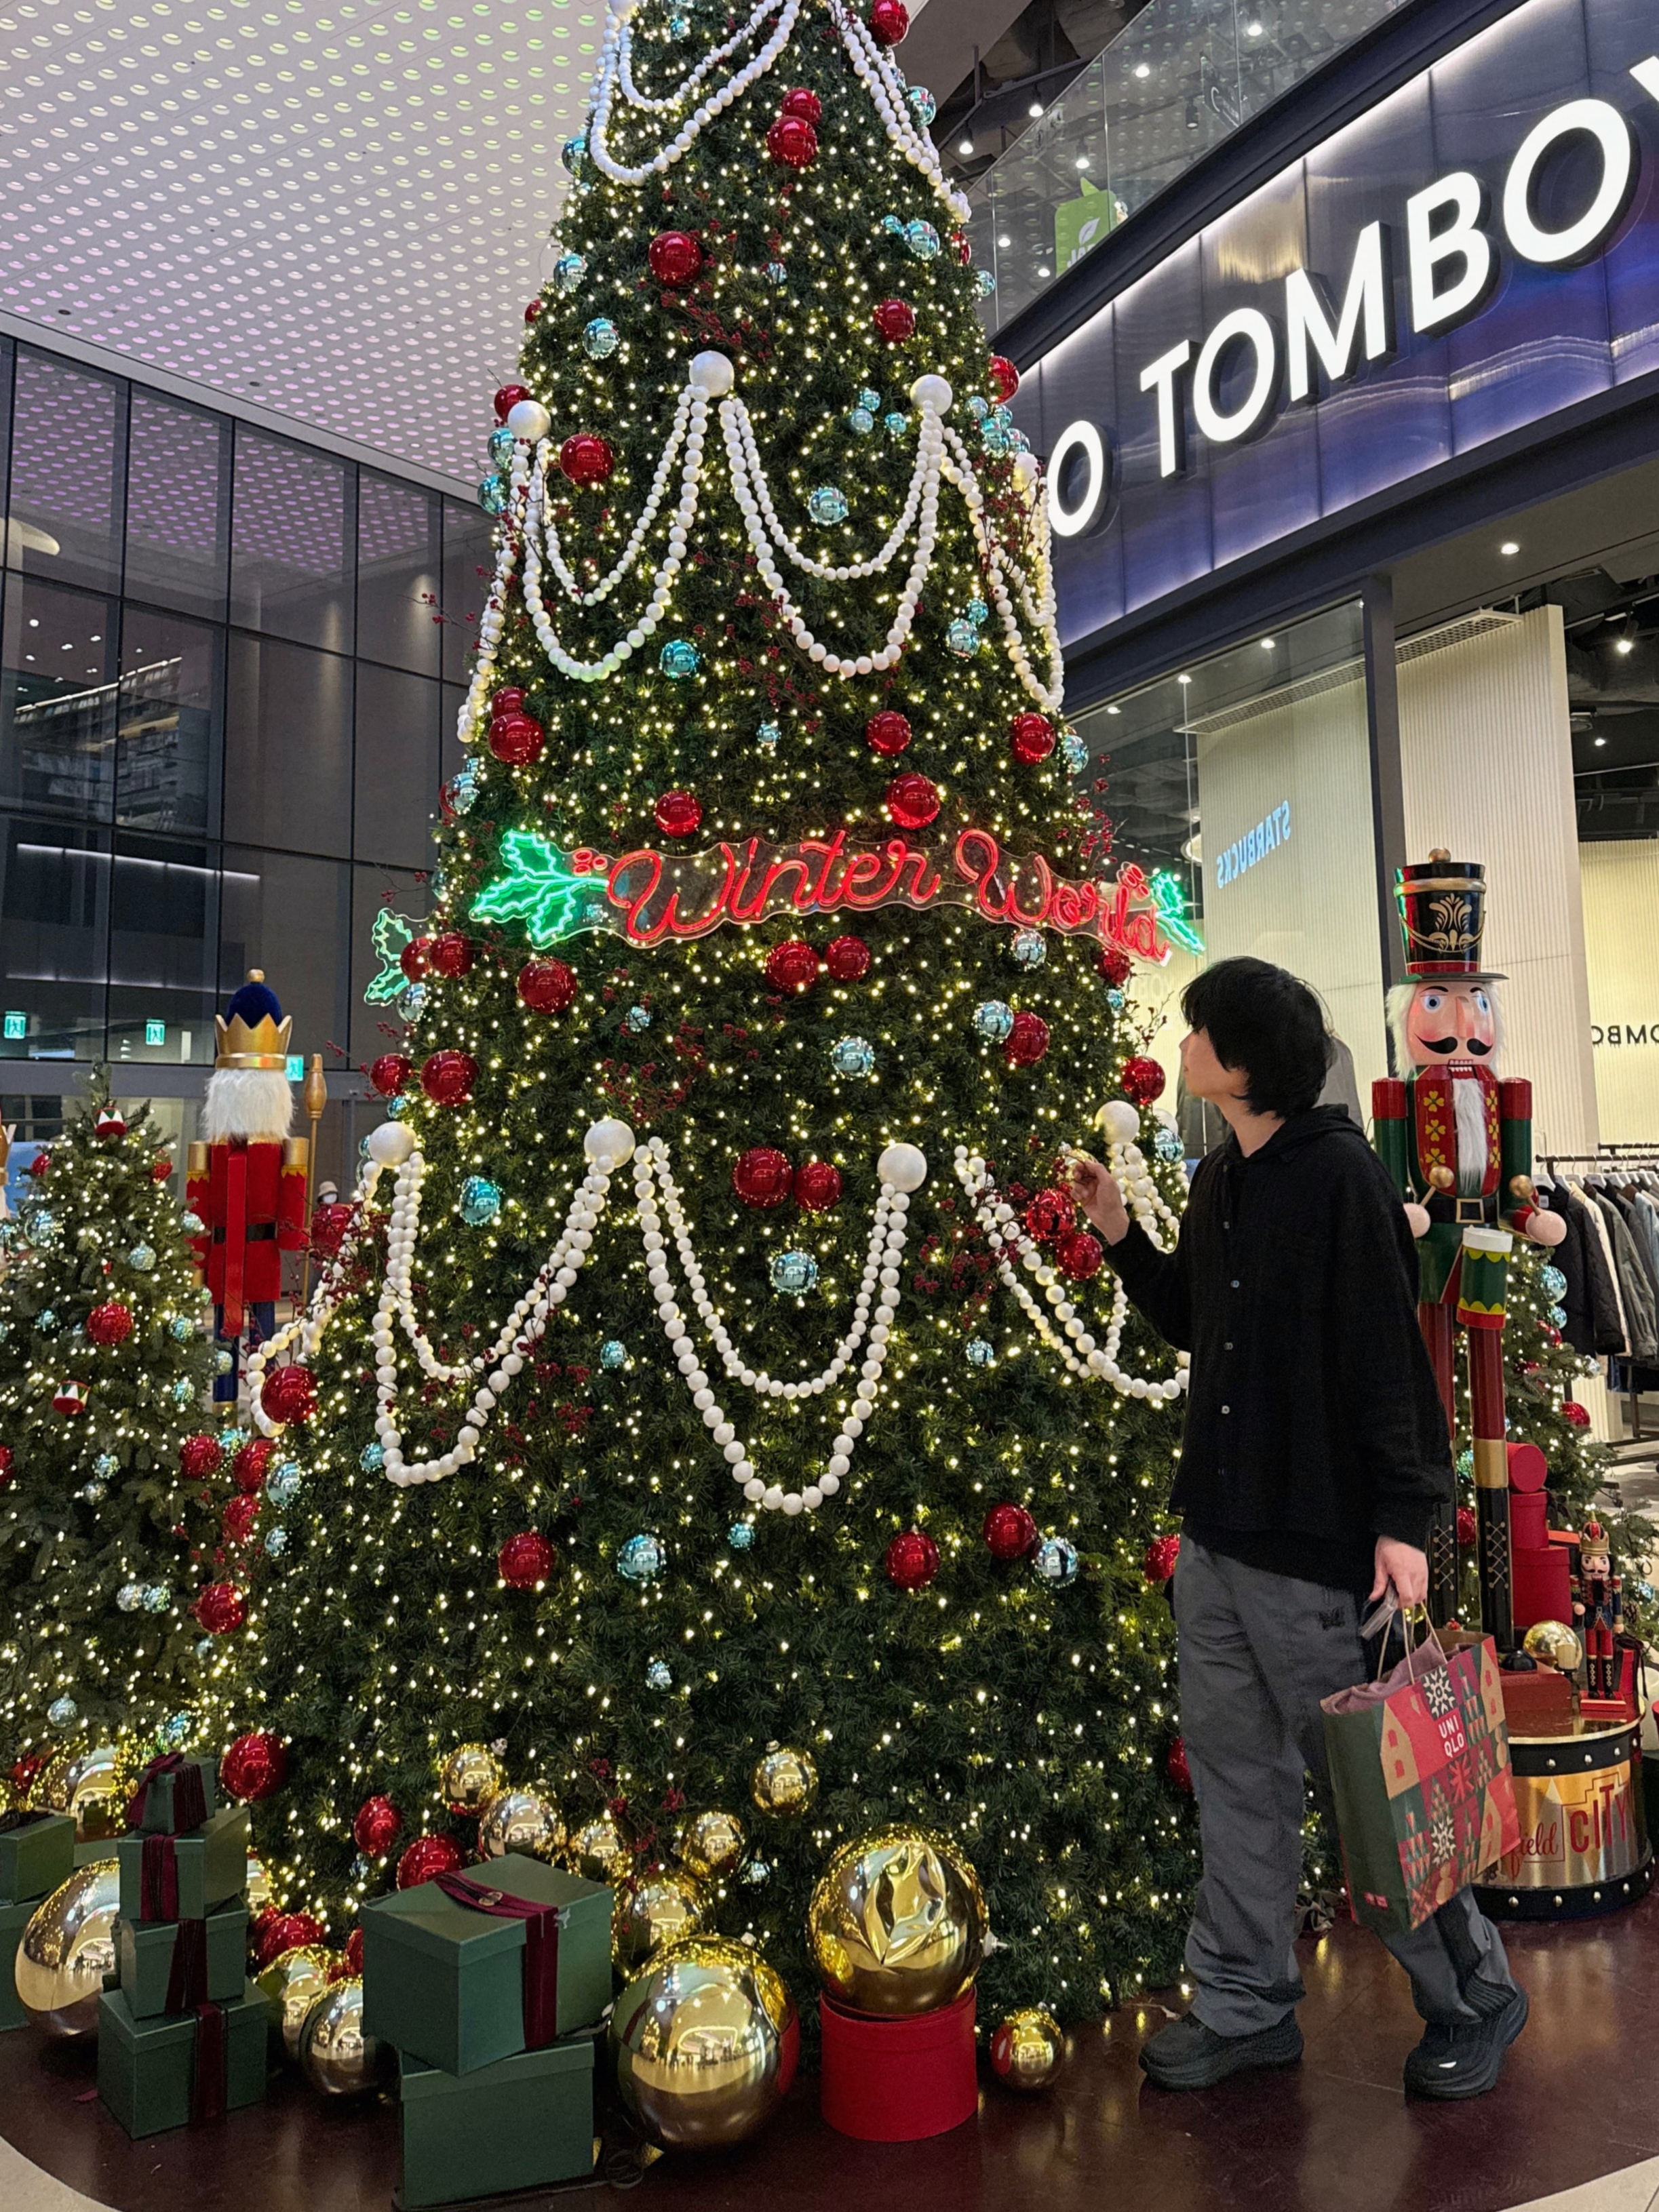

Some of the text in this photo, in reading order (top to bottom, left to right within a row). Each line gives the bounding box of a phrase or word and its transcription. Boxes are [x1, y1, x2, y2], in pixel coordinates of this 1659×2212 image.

[1140, 56, 1659, 478] TOMBO
[607, 829, 1171, 961] Winter World
[1439, 1715, 1459, 1739] UNI
[1444, 1733, 1464, 1758] QLO
[1570, 1783, 1626, 1853] CITY
